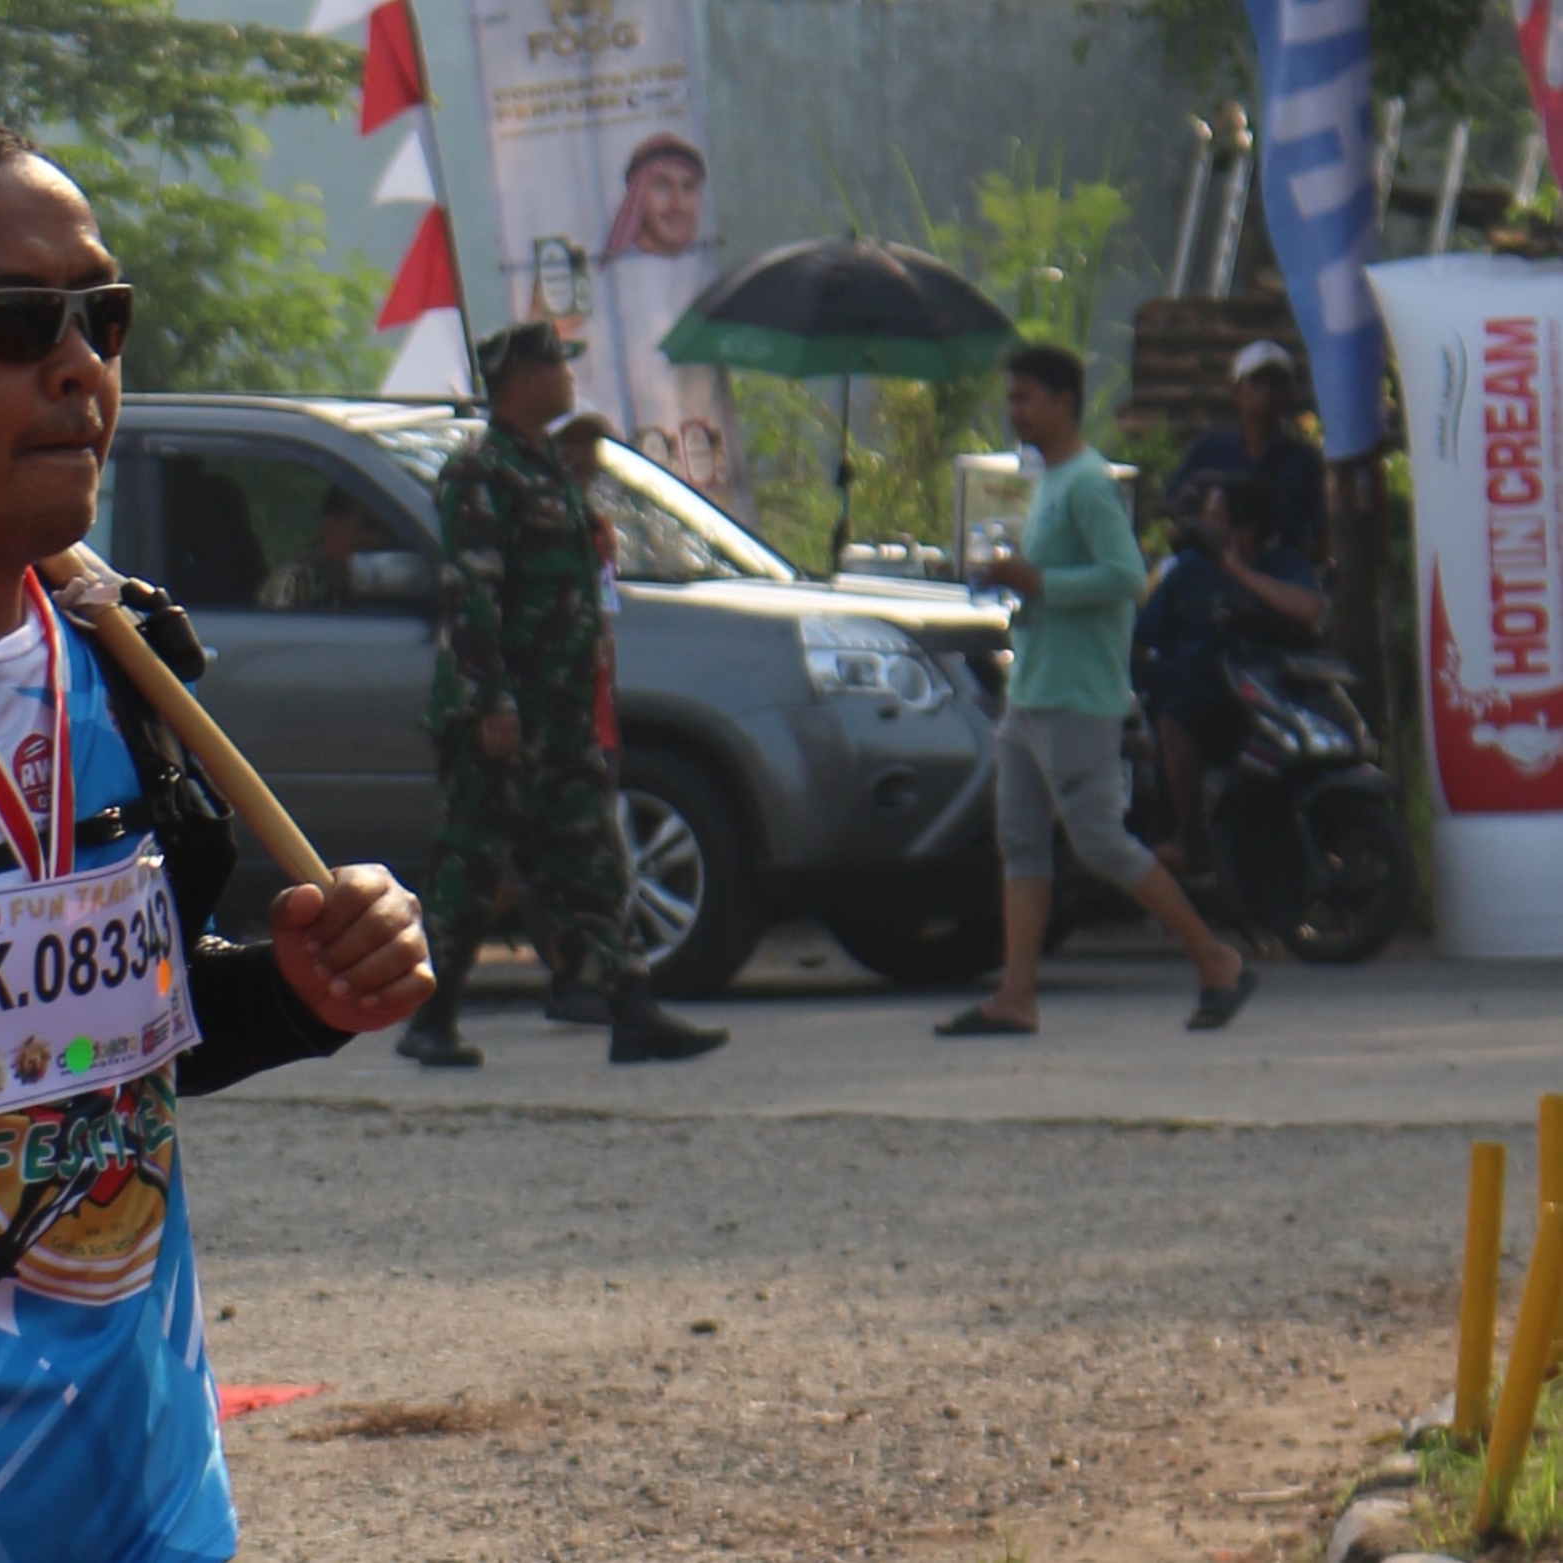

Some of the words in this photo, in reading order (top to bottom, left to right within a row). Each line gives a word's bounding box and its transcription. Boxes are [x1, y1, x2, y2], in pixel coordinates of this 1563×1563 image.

[1482, 316, 1543, 506] CREAM
[1490, 577, 1551, 678] HOT
[9, 893, 65, 927] FUN
